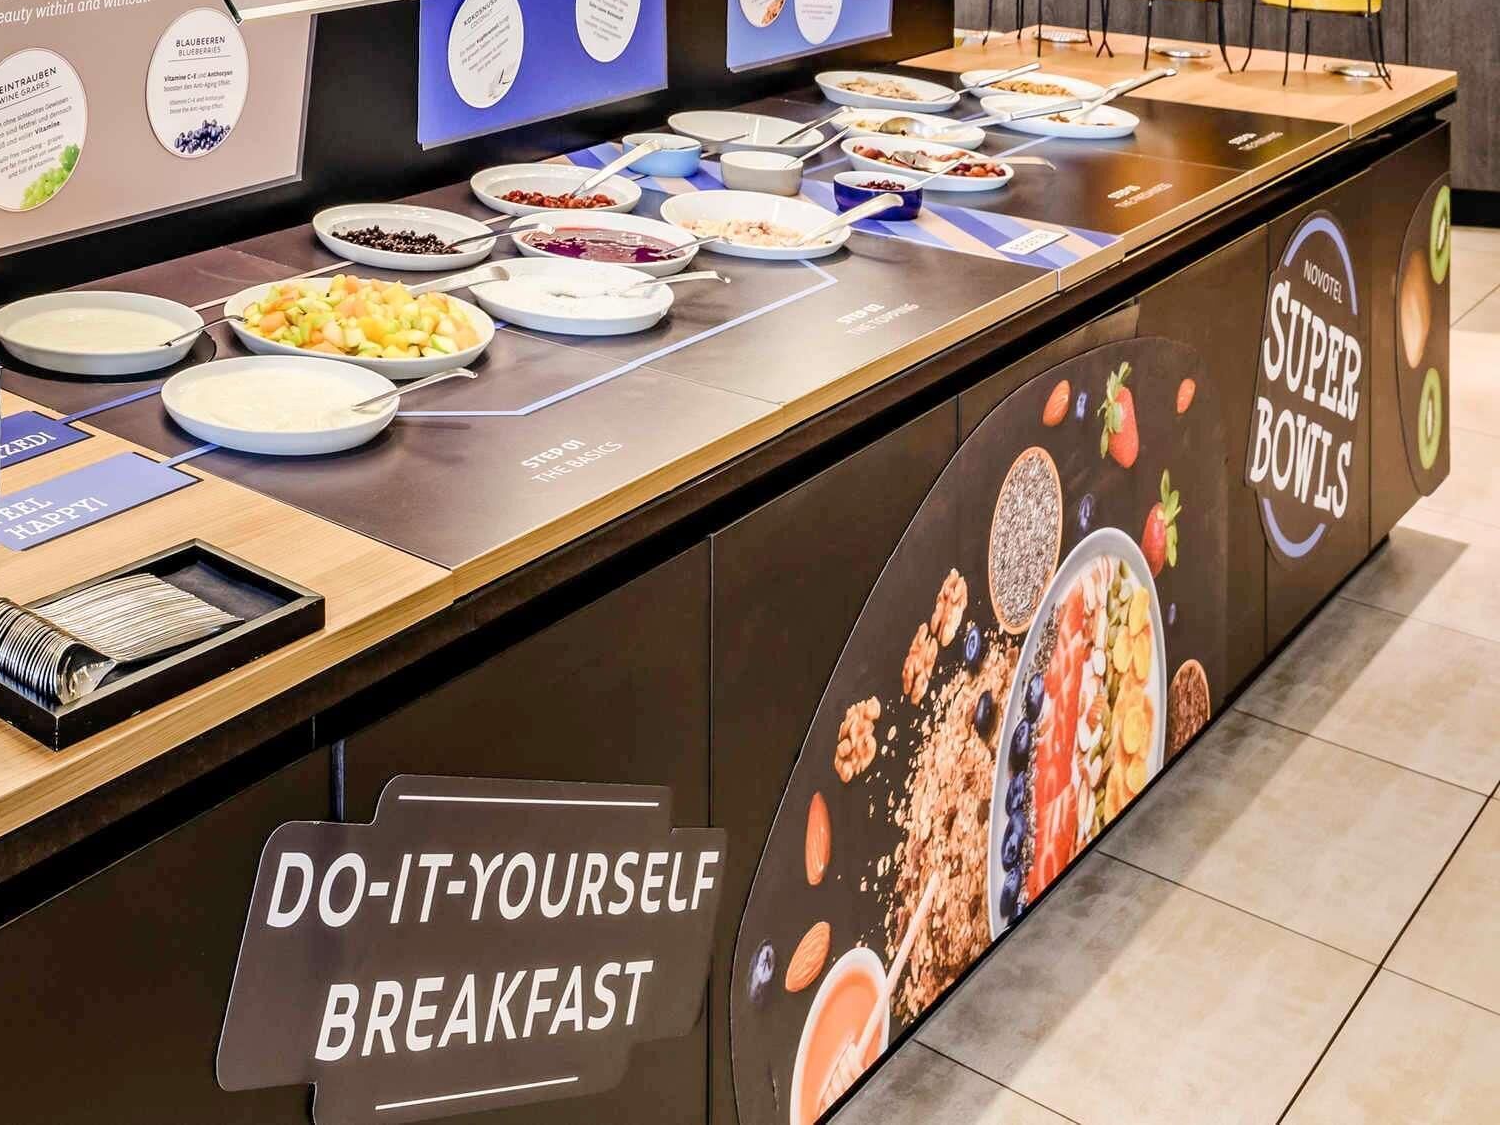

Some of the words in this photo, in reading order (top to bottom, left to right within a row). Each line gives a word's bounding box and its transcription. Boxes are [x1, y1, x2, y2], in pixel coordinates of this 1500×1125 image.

[36, 0, 75, 19] within
[176, 36, 226, 47] BLAUBEEREN
[178, 46, 221, 57] BLUEBERRIES
[20, 80, 50, 97] GRAPES
[1303, 259, 1344, 304] NOVOTEL
[1263, 279, 1362, 422] SUPER
[521, 447, 563, 469] STEP
[531, 465, 572, 483] THE
[566, 441, 623, 468] BASICS
[1250, 395, 1354, 519] BOWLS
[4, 498, 108, 539] HAPPY!
[266, 851, 720, 928] DO-IT-YOURSELF
[314, 959, 654, 1062] BREAKFAST
